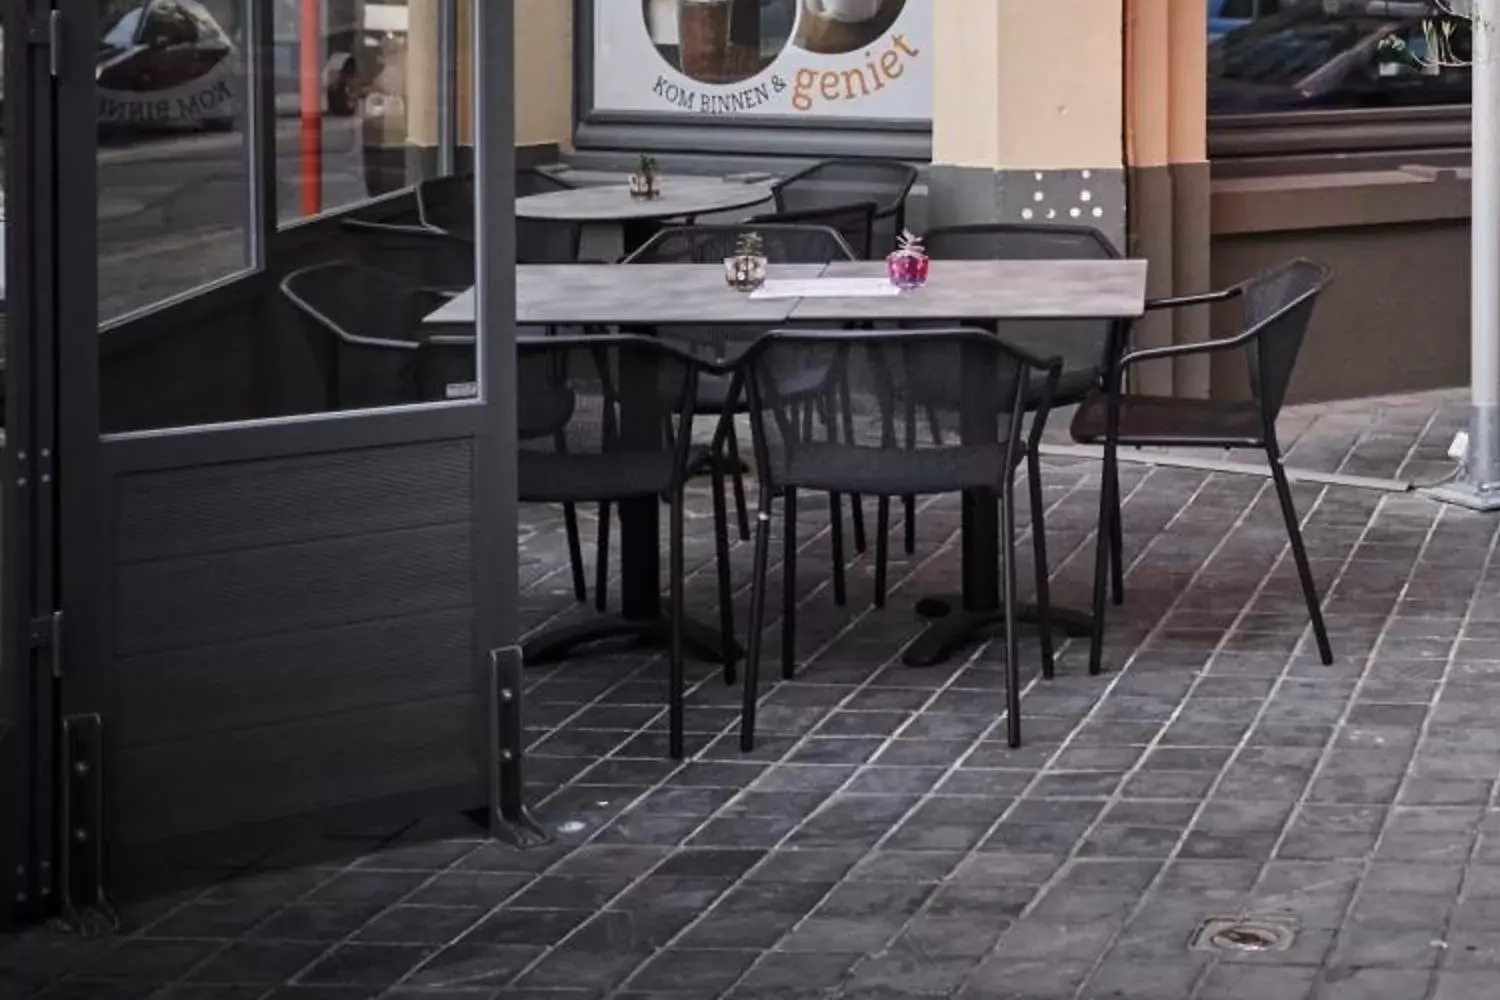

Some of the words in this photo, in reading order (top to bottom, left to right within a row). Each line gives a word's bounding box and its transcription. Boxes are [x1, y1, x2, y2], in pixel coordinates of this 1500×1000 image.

[652, 75, 695, 110] KOM
[700, 84, 770, 114] BINNEN
[771, 75, 787, 92] &
[791, 33, 919, 111] geniet
